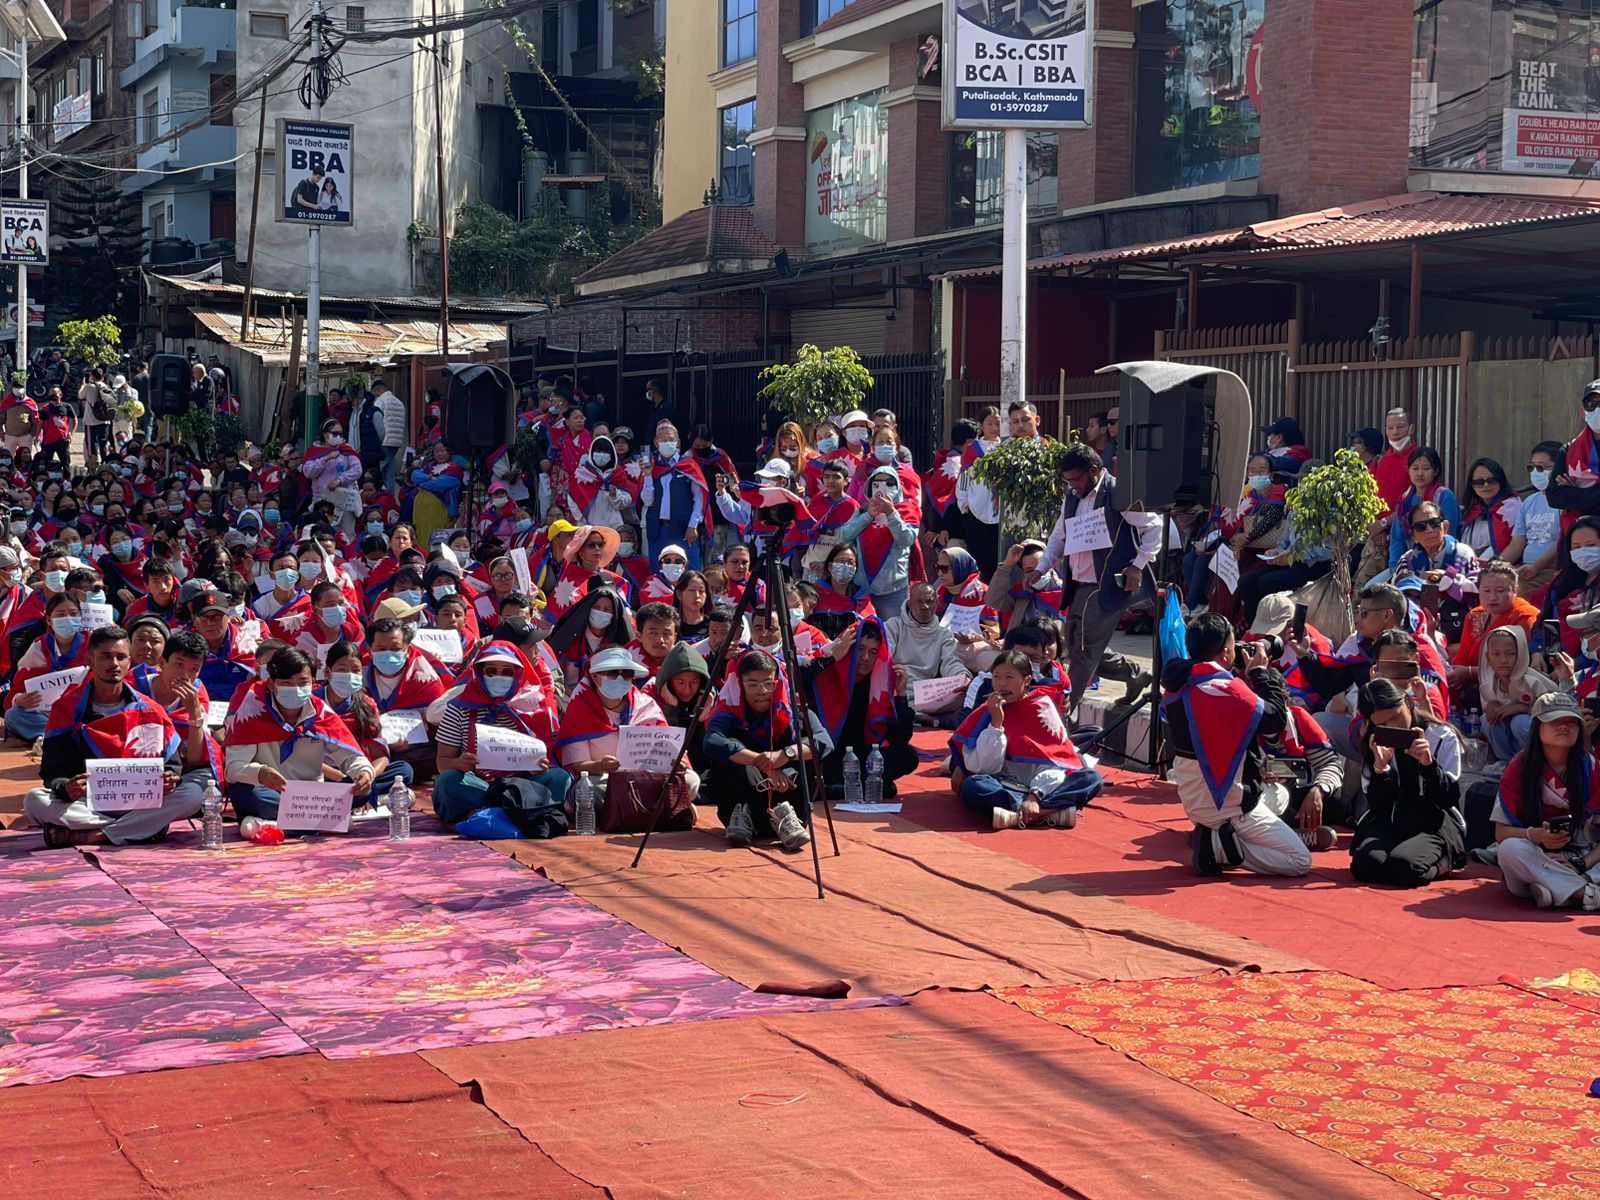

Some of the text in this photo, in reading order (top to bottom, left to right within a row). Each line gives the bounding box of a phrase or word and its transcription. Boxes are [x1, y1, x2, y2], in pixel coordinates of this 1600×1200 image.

[975, 42, 1068, 61] B.Sc.CSIT
[965, 64, 1008, 82] BCA
[1033, 66, 1077, 84] BBA
[1520, 60, 1557, 78] BEAT
[1519, 76, 1547, 93] THE
[962, 91, 1078, 102] Putalisadak, Kathmandu
[1518, 92, 1558, 110] RAIN.
[990, 103, 1049, 113] 01-5970287
[1519, 117, 1600, 130] DOUBLE HEAD RAINCOA
[1530, 132, 1560, 142] KAVACH
[1524, 146, 1553, 155] GLOVES
[1555, 147, 1573, 156] RAIN
[291, 149, 345, 173] BBA
[297, 211, 336, 220] 01-5970287
[5, 216, 43, 231] BCA
[654, 732, 680, 740] Gen-Z
[96, 763, 160, 774] रगतले लेखिएको
[97, 777, 128, 788] इतिहास
[121, 793, 134, 804] पूरा
